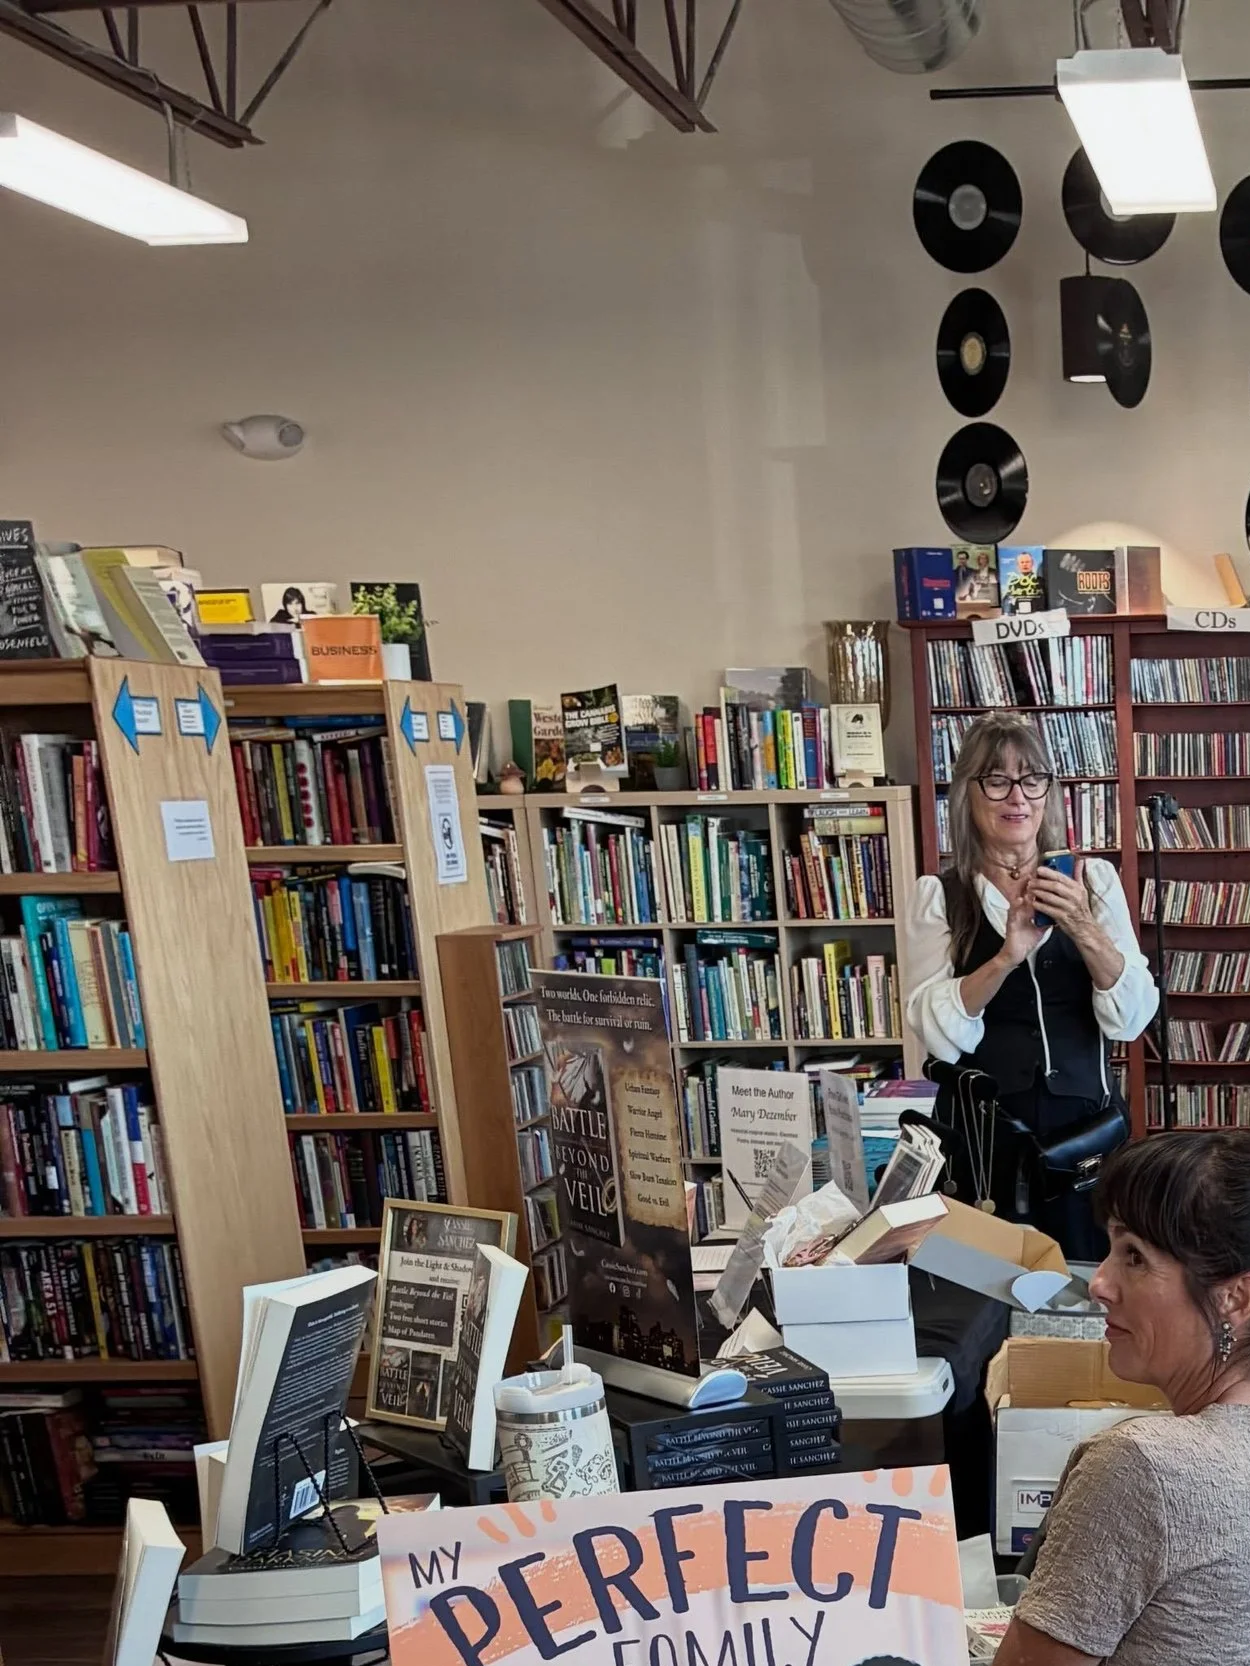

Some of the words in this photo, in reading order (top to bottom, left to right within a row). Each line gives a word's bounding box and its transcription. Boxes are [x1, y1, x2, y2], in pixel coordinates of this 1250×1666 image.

[1077, 571, 1110, 591] ROOTS
[996, 618, 1045, 640] DVDs
[1194, 611, 1236, 630] CDs
[311, 645, 378, 656] BUSINESS
[565, 709, 579, 722] THE
[565, 717, 588, 729] GROW
[588, 715, 608, 727] BIBLE
[541, 985, 557, 1000] Two
[556, 989, 582, 1001] worlds.
[583, 990, 599, 1003] One
[600, 992, 635, 1006] forbidden
[636, 995, 656, 1007] relic.
[547, 1009, 561, 1022] The
[562, 1011, 582, 1025] battle
[583, 1013, 594, 1025] for
[595, 1014, 623, 1027] survival
[624, 1019, 633, 1028] or
[634, 1019, 652, 1031] ruin.
[732, 1086, 751, 1096] Meet
[753, 1087, 767, 1097] the
[768, 1088, 794, 1098] Author
[552, 1105, 607, 1140] BATTLE
[731, 1107, 755, 1123] Mary
[757, 1108, 798, 1121] Dezember
[555, 1145, 610, 1172] BEYOND
[565, 1177, 607, 1216] VEIL
[789, 1380, 825, 1392] SANCHEZ
[790, 1435, 827, 1447] SANCHEZ
[409, 1541, 462, 1588] MY
